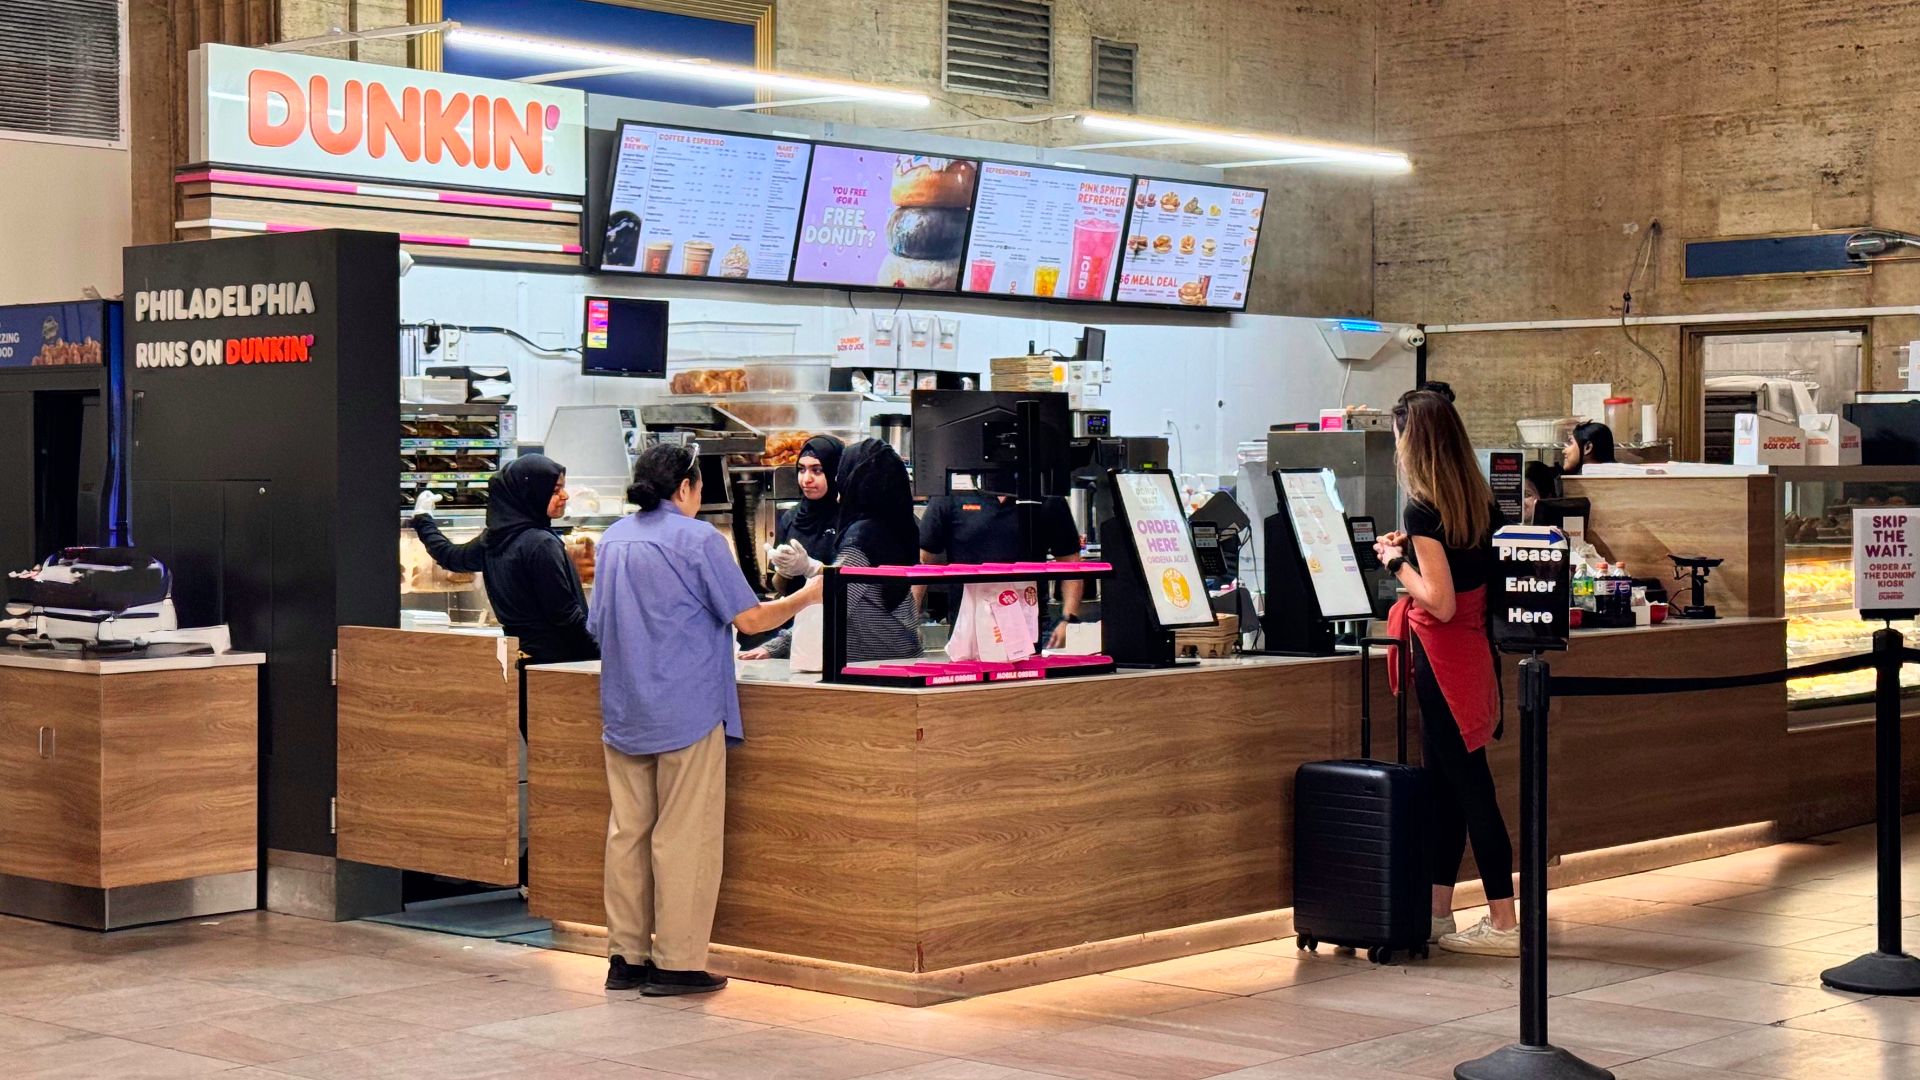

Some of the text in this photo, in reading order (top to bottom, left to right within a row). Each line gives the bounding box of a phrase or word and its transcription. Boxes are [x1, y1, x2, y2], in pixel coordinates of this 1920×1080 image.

[248, 69, 560, 175] DUNKIN'
[624, 136, 641, 144] NOW
[658, 133, 685, 143] COFFEE
[692, 137, 725, 147] ESPRESSO
[985, 166, 1019, 176] REFRESHING
[832, 186, 868, 197] YOU FREE
[1080, 182, 1127, 197] PINK SPRITZ
[836, 196, 859, 205] FOR A
[1077, 193, 1126, 208] REFRESHER
[823, 206, 866, 227] FREE
[804, 226, 876, 248] DONUT?
[1131, 275, 1154, 287] MEAL
[1156, 277, 1178, 288] DEAL
[135, 281, 315, 322] PHILADELPHIA
[136, 334, 315, 368] RUNS ON DUNKIN'
[1763, 442, 1778, 450] BOX
[1136, 519, 1180, 534] ORDER
[1872, 515, 1908, 529] SKIP
[1873, 530, 1905, 543] THE
[1146, 538, 1181, 552] HERE
[1865, 545, 1913, 558] WAIT.
[1498, 546, 1563, 563] Please
[1869, 563, 1899, 571] ORDER
[1864, 571, 1916, 580] THE DUNKIN'
[1505, 576, 1556, 593] Enter
[1878, 580, 1905, 588] KIOSK
[1508, 607, 1553, 624] Here
[932, 674, 977, 685] MOBILE ORDERS
[996, 670, 1039, 680] MOBILE ORDERS
